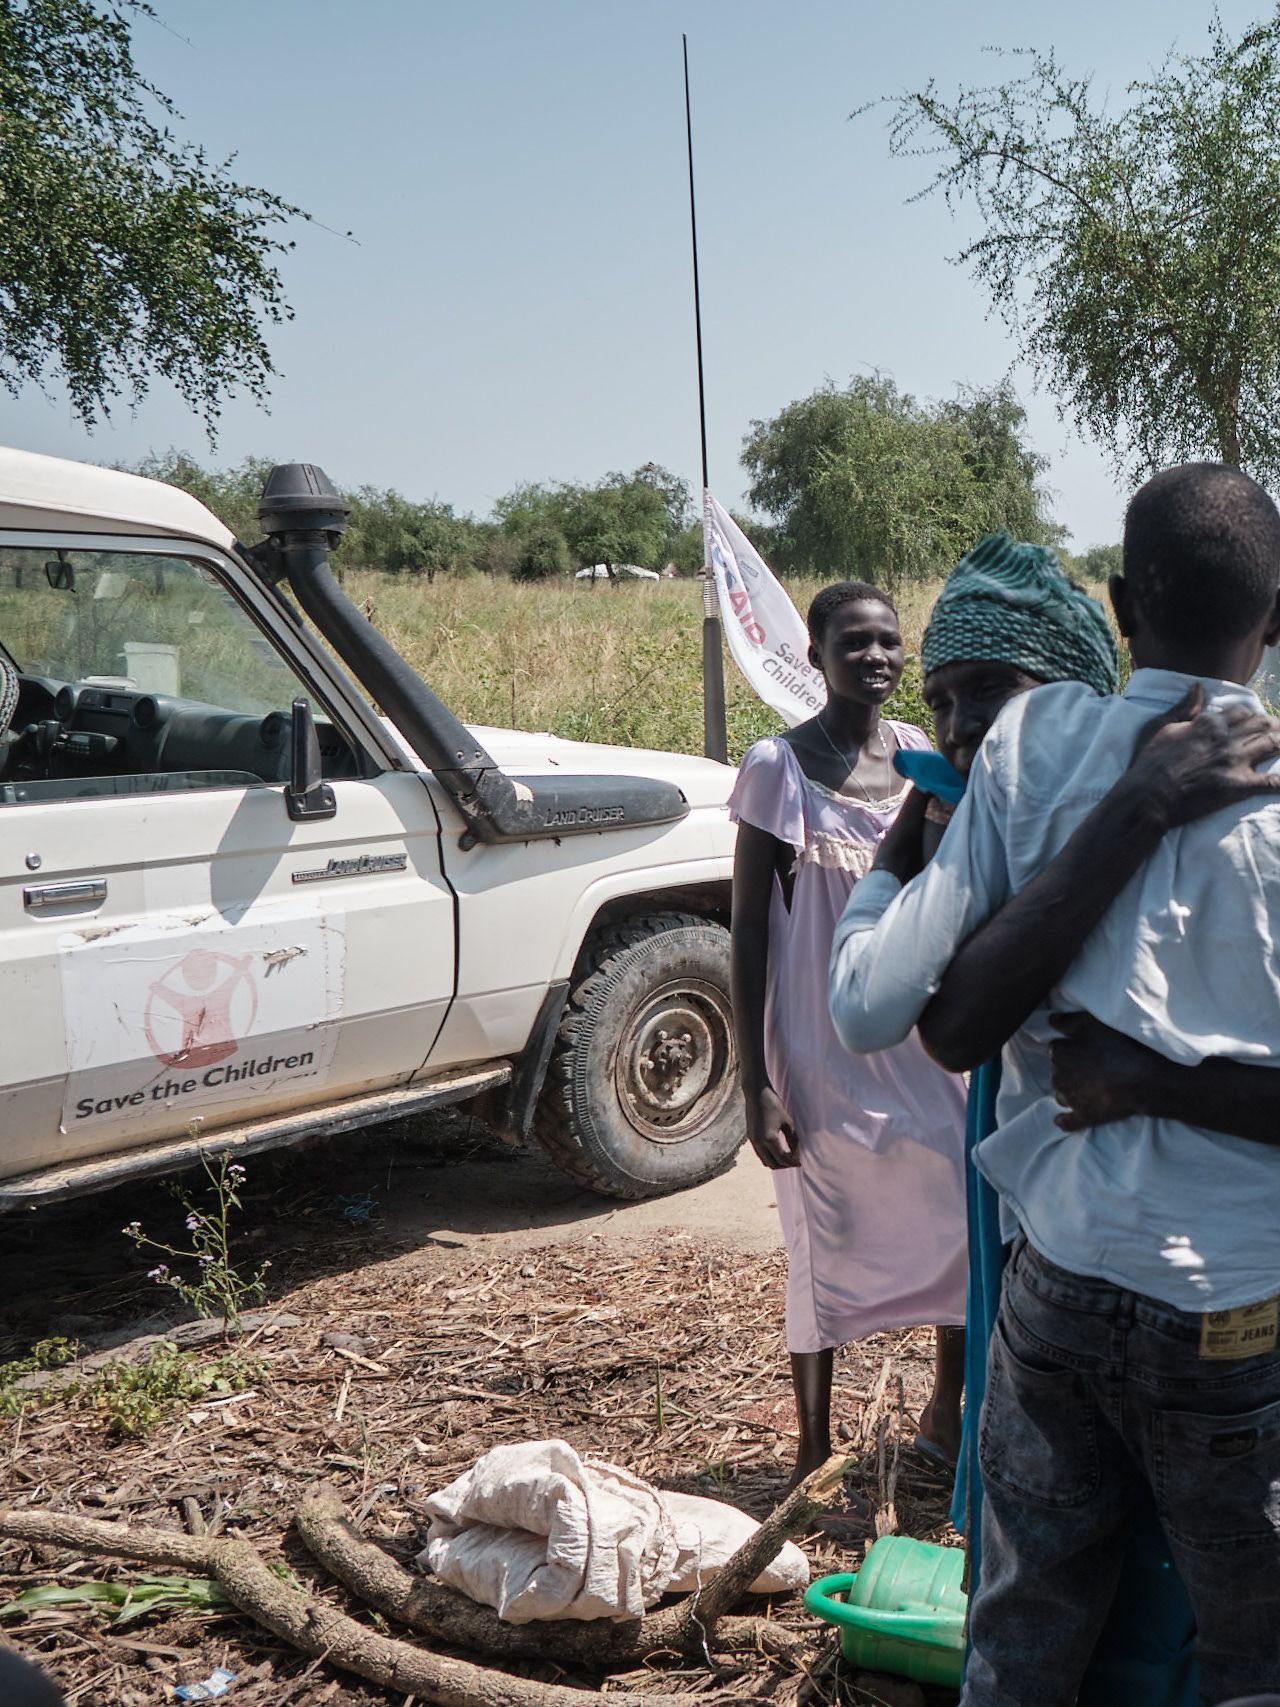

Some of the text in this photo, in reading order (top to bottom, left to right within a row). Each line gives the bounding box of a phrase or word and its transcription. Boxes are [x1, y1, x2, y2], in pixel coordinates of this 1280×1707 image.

[775, 642, 811, 677] Save
[543, 805, 624, 827] LAND CRUISER
[75, 1051, 314, 1119] Save the Children
[1240, 1324, 1276, 1342] JEANS
